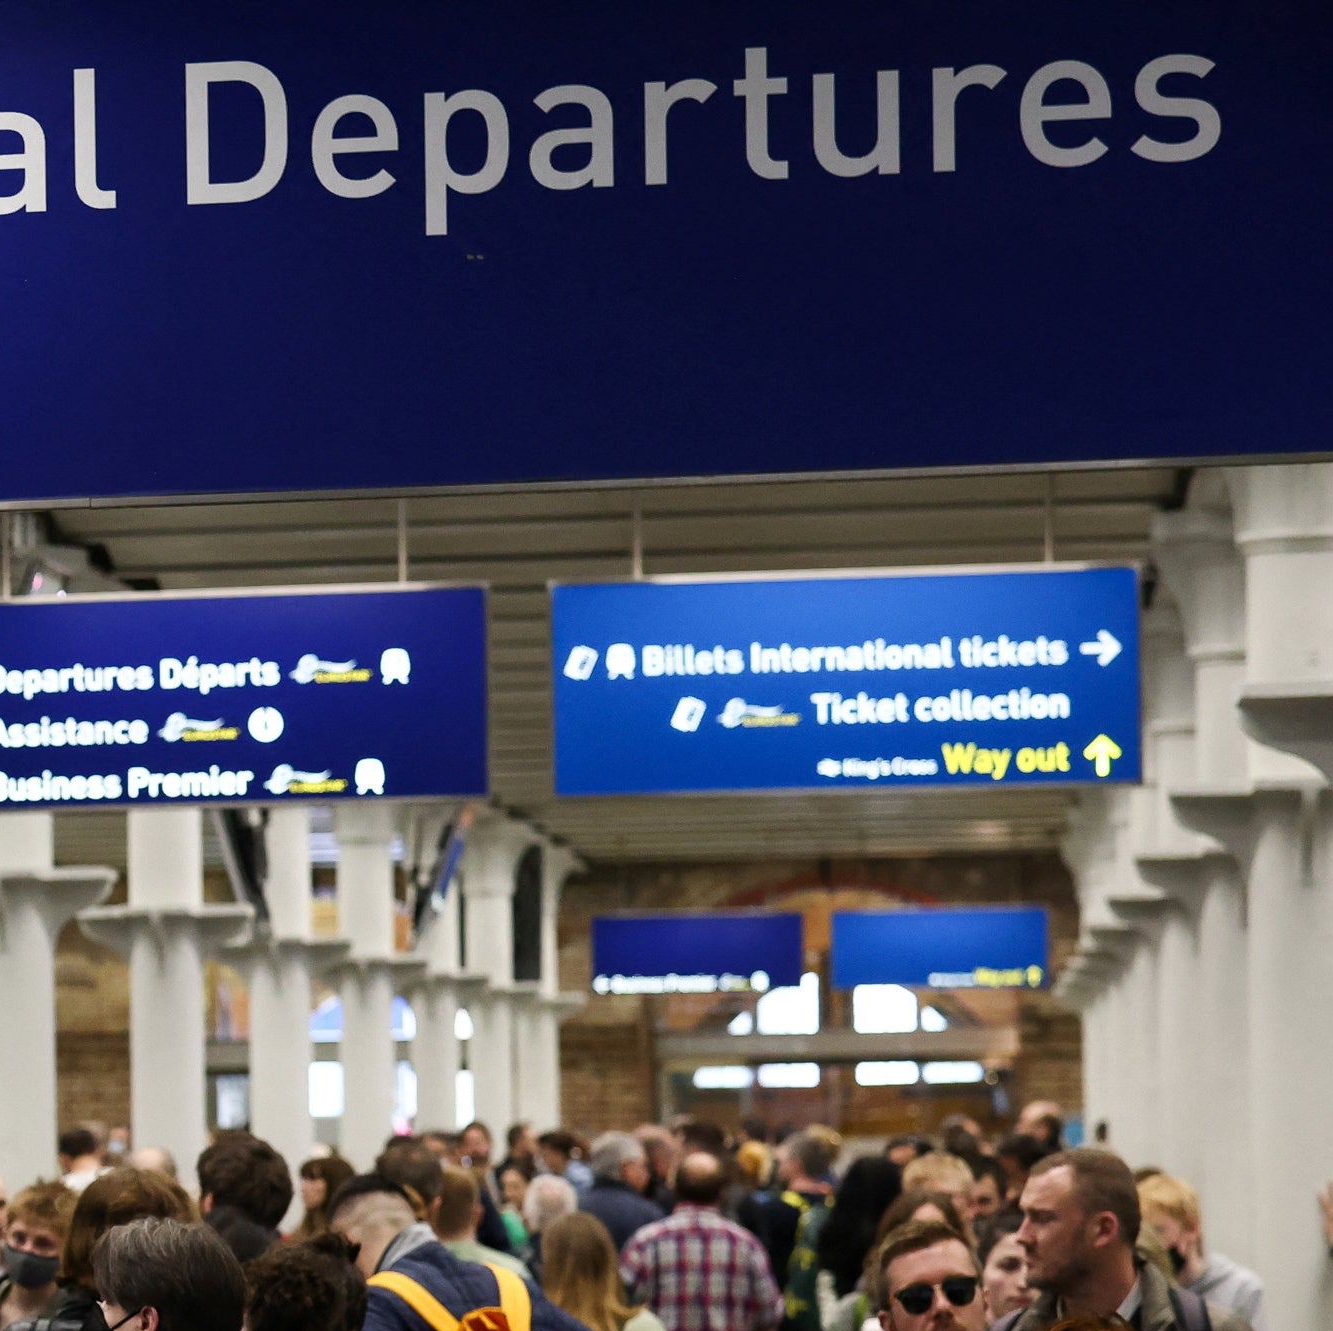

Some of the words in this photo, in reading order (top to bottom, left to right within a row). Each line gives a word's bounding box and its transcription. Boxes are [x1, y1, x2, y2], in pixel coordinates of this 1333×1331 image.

[184, 47, 1221, 237] Departures
[159, 655, 281, 695] Départs
[641, 643, 745, 677] Billets
[749, 636, 955, 674] International
[958, 634, 1069, 668] tickets
[809, 691, 910, 725] Ticket
[913, 687, 1071, 723] collection
[941, 742, 1012, 781] Way
[1015, 741, 1070, 773] out
[127, 764, 255, 799] Premier
